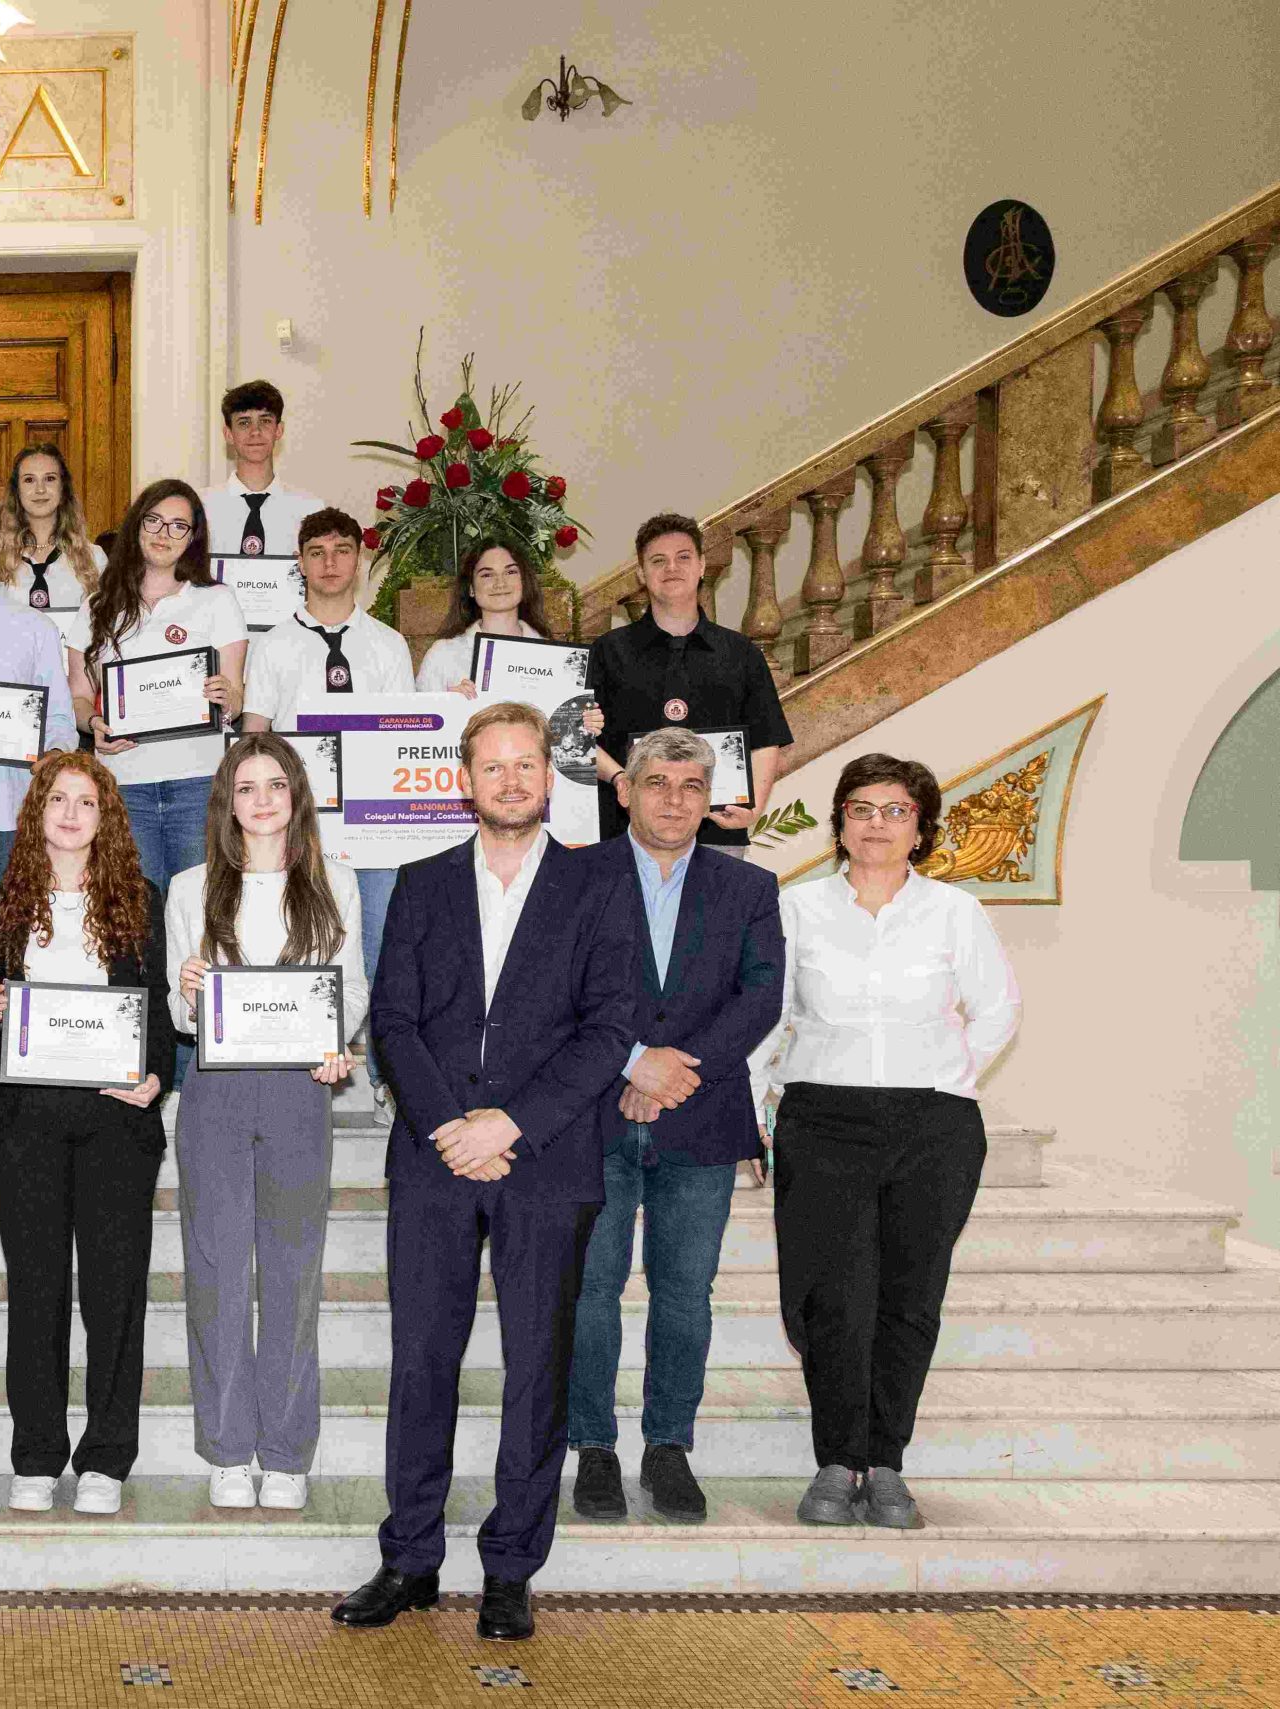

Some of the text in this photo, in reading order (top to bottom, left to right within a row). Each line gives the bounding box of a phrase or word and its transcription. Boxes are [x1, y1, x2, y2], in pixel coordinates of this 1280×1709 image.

[237, 580, 278, 590] DIPLOMĂ
[507, 664, 554, 677] DIPLOMĂ
[139, 677, 182, 692] DIPLOMĂ
[398, 746, 462, 759] PREMIU
[365, 813, 396, 821] Colegiul
[323, 852, 338, 860] NG
[242, 1000, 299, 1012] DIPLOMĂ
[49, 1018, 104, 1030] DIPLOMĂ
